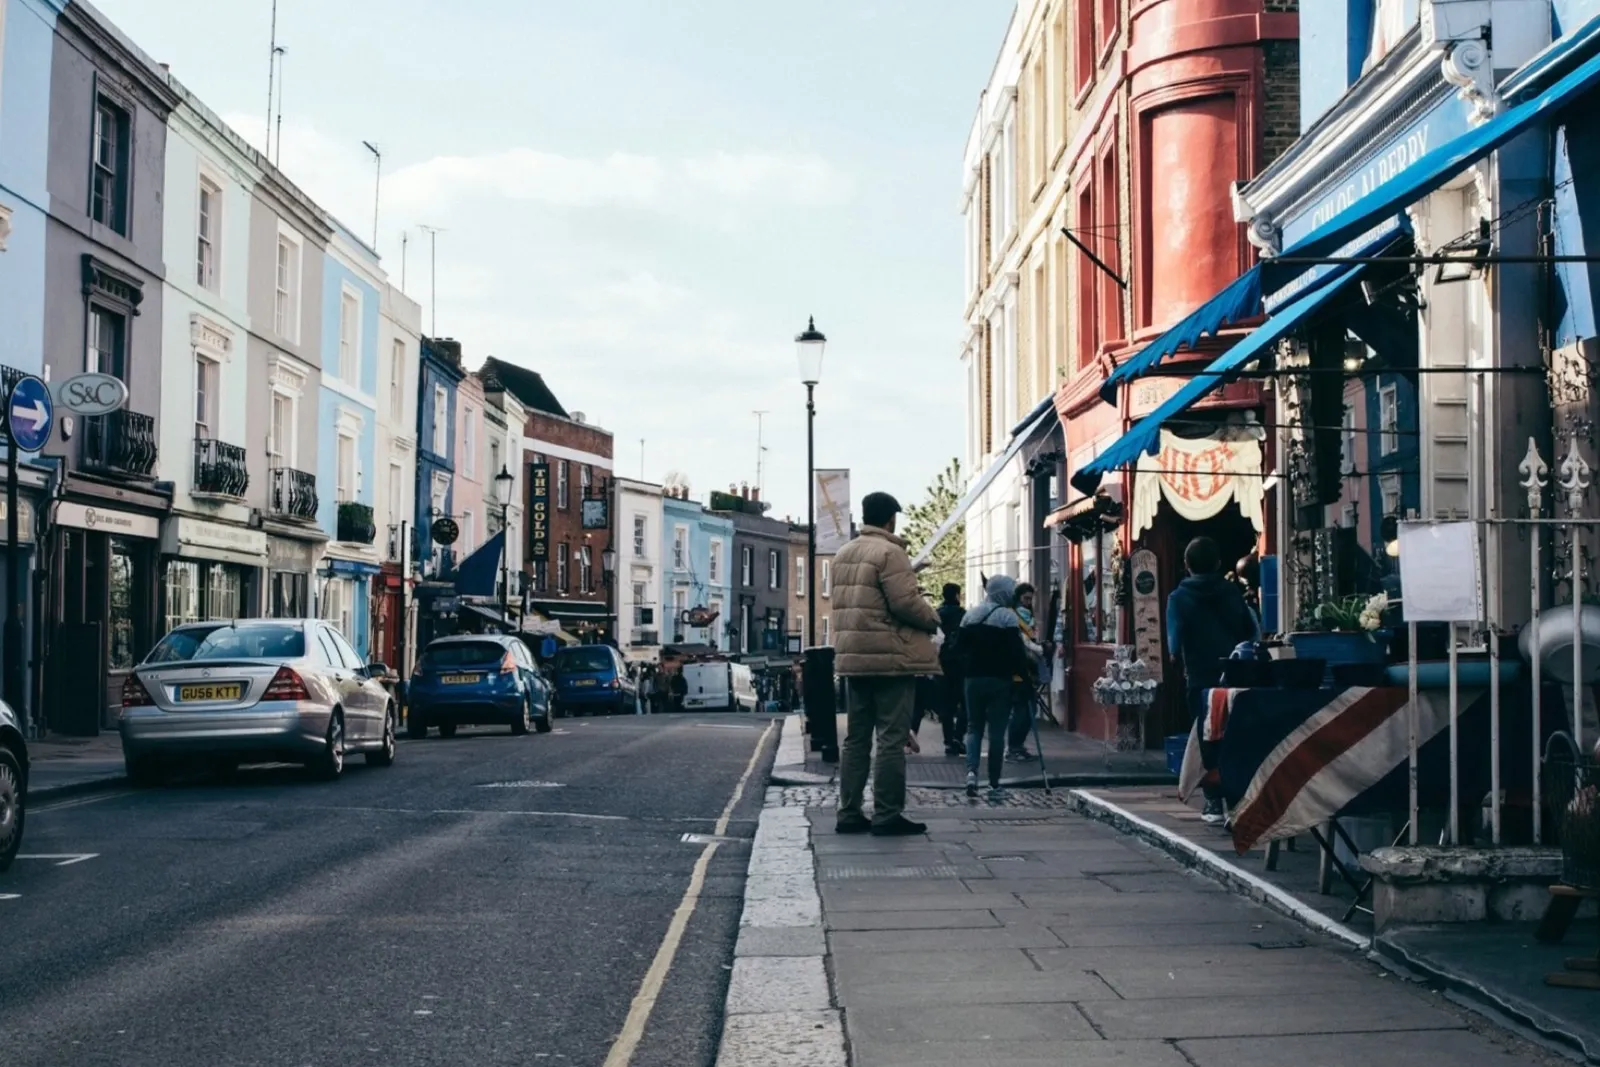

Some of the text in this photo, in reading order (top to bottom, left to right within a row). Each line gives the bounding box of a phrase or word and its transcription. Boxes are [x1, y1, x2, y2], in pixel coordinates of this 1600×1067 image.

[69, 382, 115, 406] S&C
[534, 469, 546, 496] THE
[534, 502, 545, 539] GOLD
[182, 686, 239, 699] GU56 KTT
